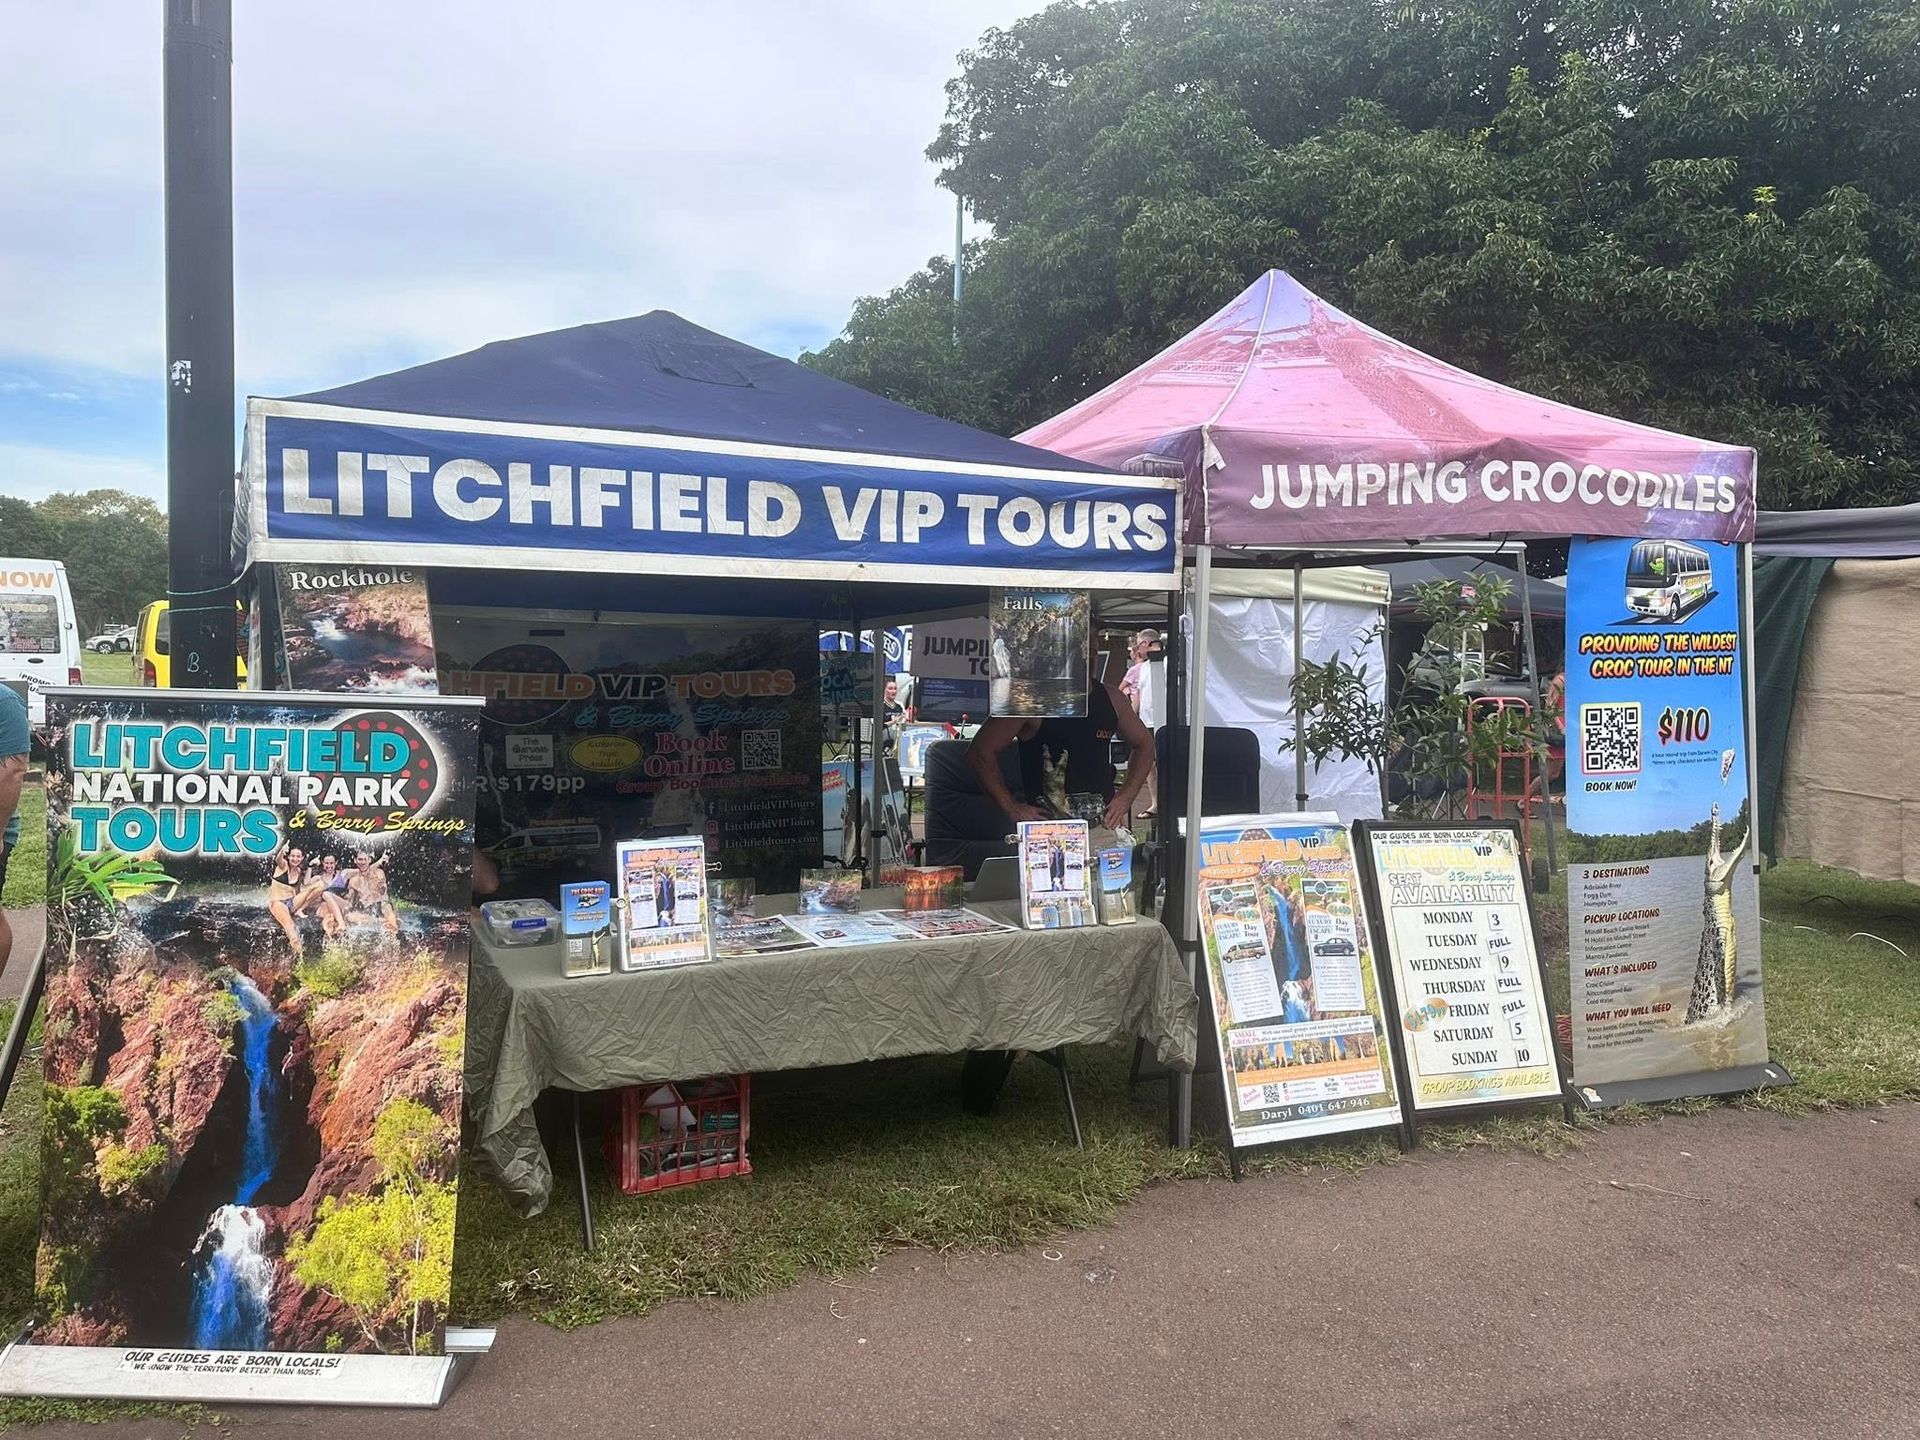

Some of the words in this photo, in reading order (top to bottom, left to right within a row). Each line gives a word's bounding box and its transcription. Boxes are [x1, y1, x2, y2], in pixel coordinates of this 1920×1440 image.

[1249, 461, 1468, 510] JUMPING
[1480, 460, 1737, 513] CROCODILES
[281, 447, 802, 537] LITCHFIELD
[822, 486, 944, 544] VIP
[957, 493, 1168, 552] TOURS
[289, 567, 414, 591] Rockhole
[1003, 596, 1043, 610] Falls
[1580, 634, 1660, 654] PROVIDING
[1664, 633, 1690, 652] THE
[1690, 632, 1737, 652] WILDEST
[1591, 658, 1634, 678] CROC
[1636, 656, 1674, 677] TOUR
[1677, 656, 1691, 675] IN
[1694, 656, 1716, 674] THE
[1718, 655, 1734, 674] NT
[599, 672, 668, 699] VIP
[671, 669, 796, 697] TOURS
[575, 705, 599, 728] &
[608, 705, 684, 729] Berry
[692, 703, 791, 725] Springs
[1658, 706, 1710, 745] $110
[72, 723, 410, 774] LITCHFIELD
[655, 730, 728, 754] Book
[643, 753, 736, 777] Online
[73, 772, 290, 805] NATIONAL
[298, 774, 409, 807] PARK
[498, 774, 586, 794] $179pp
[1585, 782, 1612, 792] BOOK
[1614, 780, 1637, 791] NOW!
[71, 807, 278, 854] TOURS
[288, 811, 304, 829] &
[315, 809, 376, 833] Berry
[383, 812, 467, 833] Springs
[1300, 837, 1319, 849] VIP
[1373, 832, 1387, 840] OUR
[1419, 831, 1431, 839] ARE
[1434, 831, 1452, 839] BORN
[1474, 846, 1492, 857] VIP
[1260, 862, 1270, 875] &
[1272, 860, 1306, 875] Berry
[1308, 860, 1352, 874] Springs
[1583, 870, 1589, 879] 3
[1592, 865, 1650, 879] DESTINATIONS
[1388, 873, 1421, 887] SEAT
[1391, 884, 1515, 904] AVAILABILITY
[1335, 917, 1348, 927] Day
[1423, 911, 1473, 925] MONDAY
[1492, 913, 1501, 926] 3
[1584, 913, 1616, 924] PICKUP
[1618, 908, 1660, 921] LOCATIONS
[1425, 934, 1477, 948] TUESDAY
[1489, 936, 1511, 949] FULL
[1409, 956, 1482, 972] WEDNESDAY
[1502, 956, 1510, 968] 9
[1584, 965, 1619, 977] WHAT'S
[1620, 961, 1657, 974] INCLUDED
[1423, 979, 1486, 995] THURSDAY
[1498, 977, 1522, 988] FULL
[1449, 1003, 1490, 1018] FRIDAY
[1502, 999, 1525, 1014] FULL
[1585, 1011, 1611, 1022] WHAT
[1613, 1008, 1629, 1019] YOU
[1631, 1005, 1649, 1016] WILL
[1652, 1002, 1672, 1013] NEED
[1433, 1026, 1494, 1043] SATURDAY
[1514, 1022, 1522, 1035] 5
[1452, 1050, 1498, 1066] SUNDAY
[1517, 1049, 1530, 1062] 10
[1422, 1080, 1455, 1094] GROUP
[1456, 1076, 1503, 1091] BOOKINGS
[1505, 1071, 1551, 1086] AVAILABLE
[1261, 1108, 1293, 1121] Daryl
[1297, 1103, 1324, 1116] 0401
[1328, 1099, 1347, 1112] 647
[1350, 1097, 1370, 1109] 946
[124, 1351, 154, 1362] OUR
[157, 1352, 211, 1364] GUIDES
[215, 1354, 240, 1365] ARE
[245, 1355, 282, 1367] BORN
[285, 1357, 342, 1368] LOCALS!
[134, 1362, 146, 1371] WE
[175, 1364, 193, 1372] THE
[193, 1365, 237, 1373] TERRITORY
[239, 1367, 270, 1375] BETTER
[273, 1368, 295, 1376] THAN
